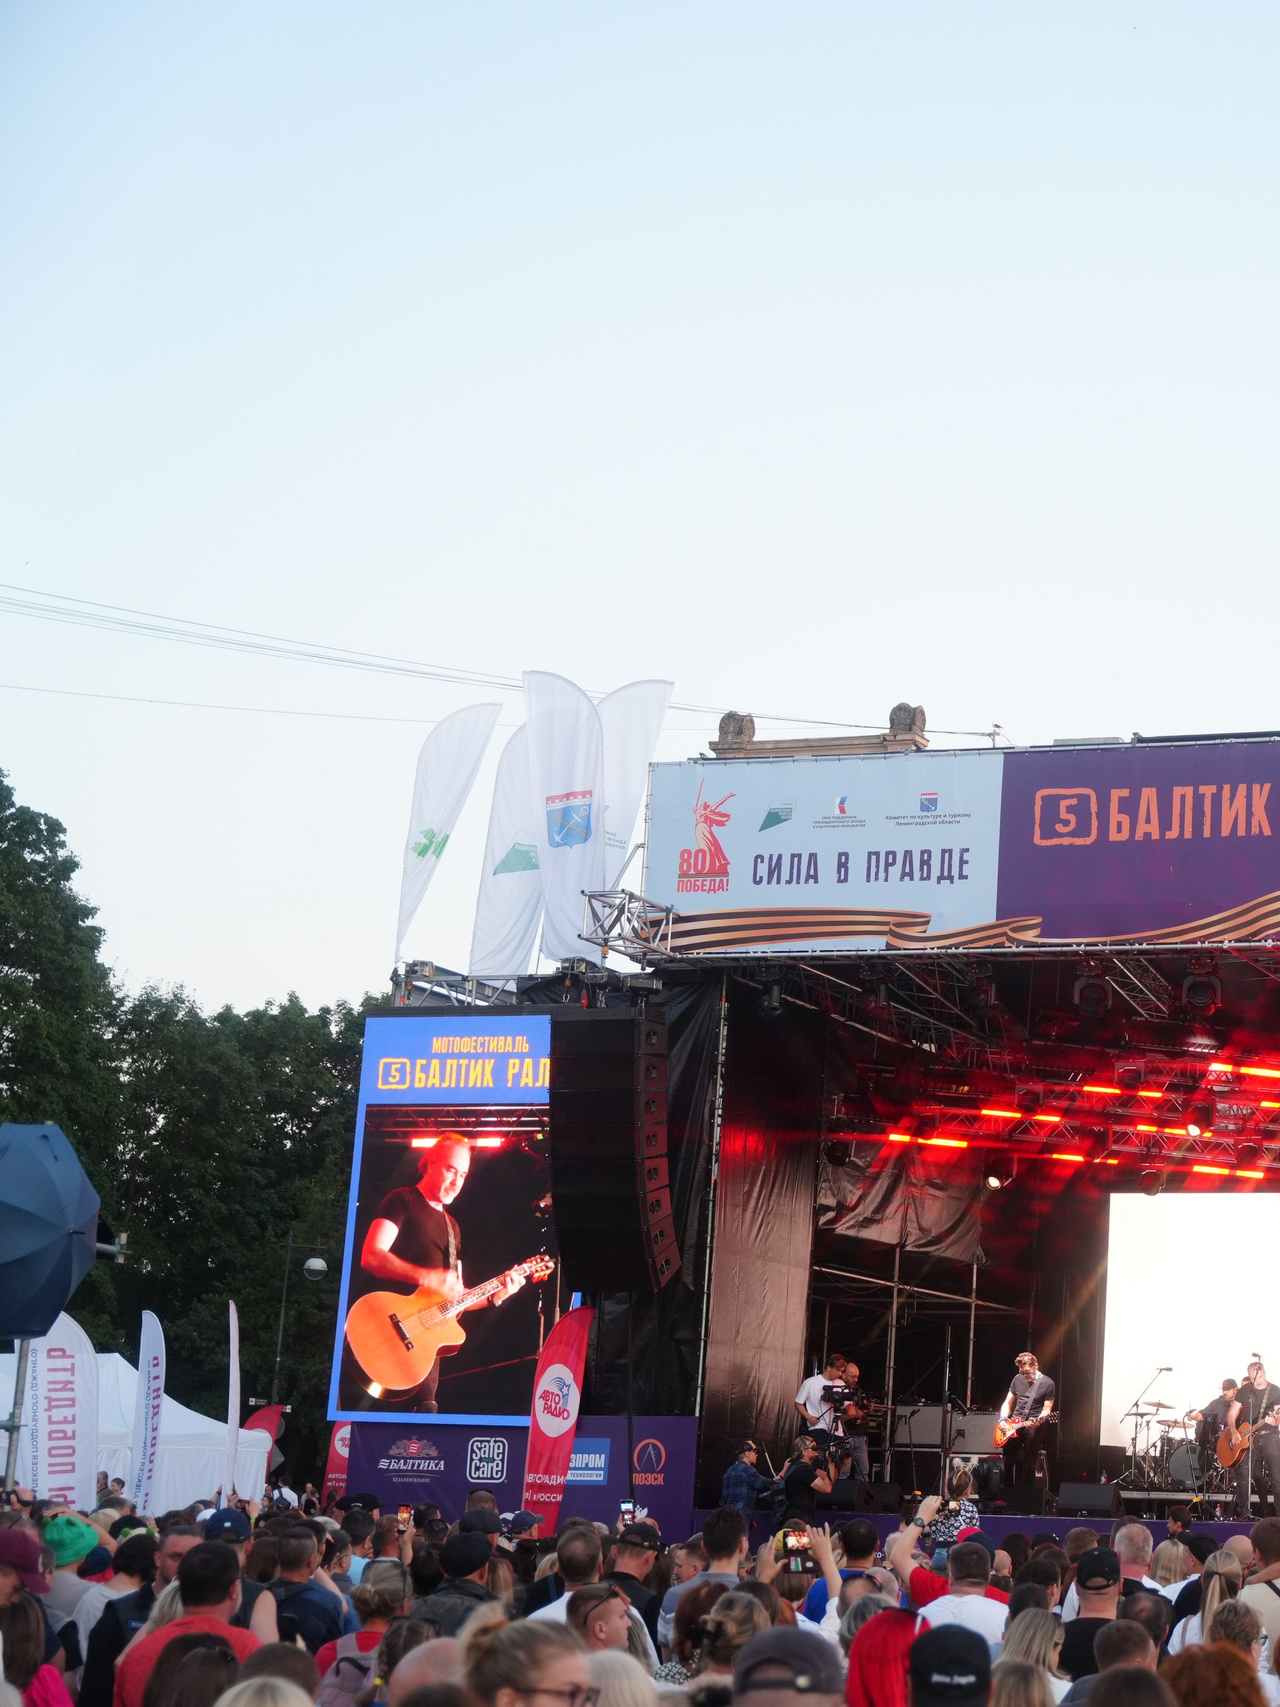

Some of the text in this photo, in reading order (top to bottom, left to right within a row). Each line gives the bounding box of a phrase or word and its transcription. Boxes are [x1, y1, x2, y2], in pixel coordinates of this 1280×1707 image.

[1054, 797, 1078, 833] 5
[1108, 783, 1272, 841] БАЛТИК
[678, 848, 708, 875] 80
[752, 847, 970, 885] СИЛА В ПРАВДЕ
[677, 878, 729, 893] ПОБЕДА!
[432, 1036, 529, 1054] МОТОФЕСТИВАЛЬ
[388, 1057, 550, 1088] 5 БАЛТИК РАЛ
[538, 1389, 560, 1406] АВТО
[543, 1401, 570, 1421] РАДИО
[472, 1437, 503, 1460] safe
[389, 1459, 444, 1471] БАЛТИКА
[471, 1459, 502, 1479] care
[569, 1454, 605, 1468] ЗПРОМ
